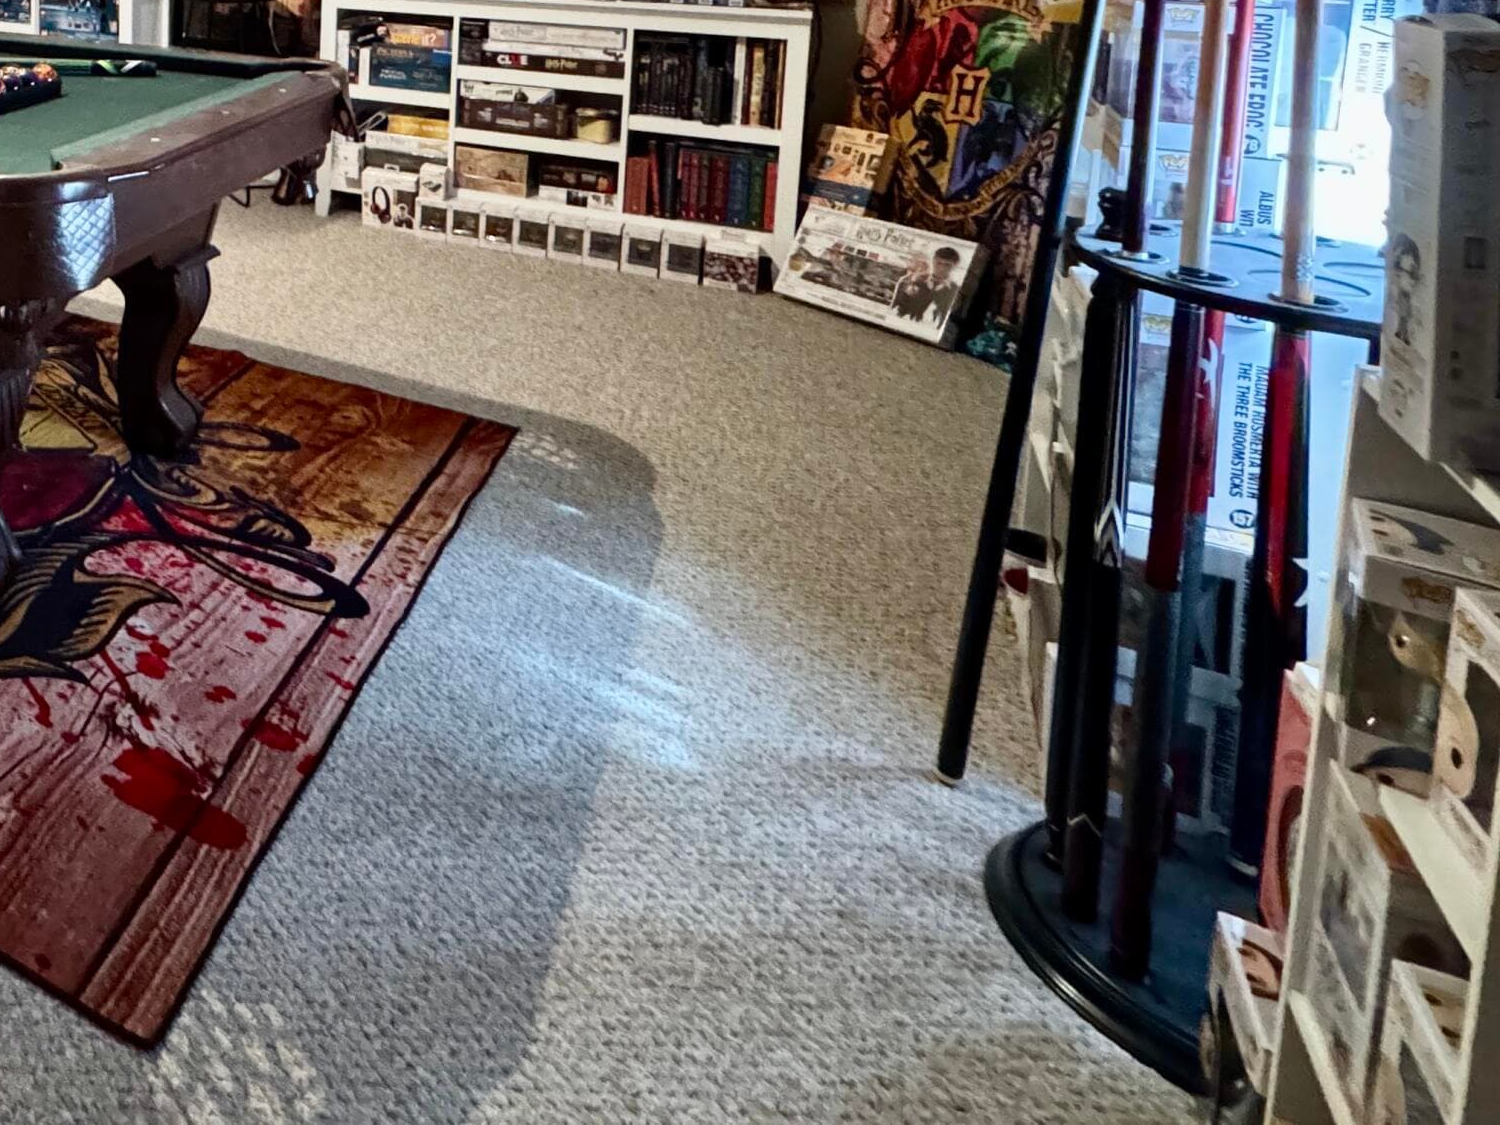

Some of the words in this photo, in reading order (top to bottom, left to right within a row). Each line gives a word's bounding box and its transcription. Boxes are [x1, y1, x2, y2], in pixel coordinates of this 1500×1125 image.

[951, 73, 985, 118] H
[1257, 191, 1275, 225] ALBUS
[1237, 362, 1253, 381] THE
[1234, 384, 1250, 418] THREE
[1229, 421, 1248, 498] BROOMSTICKS
